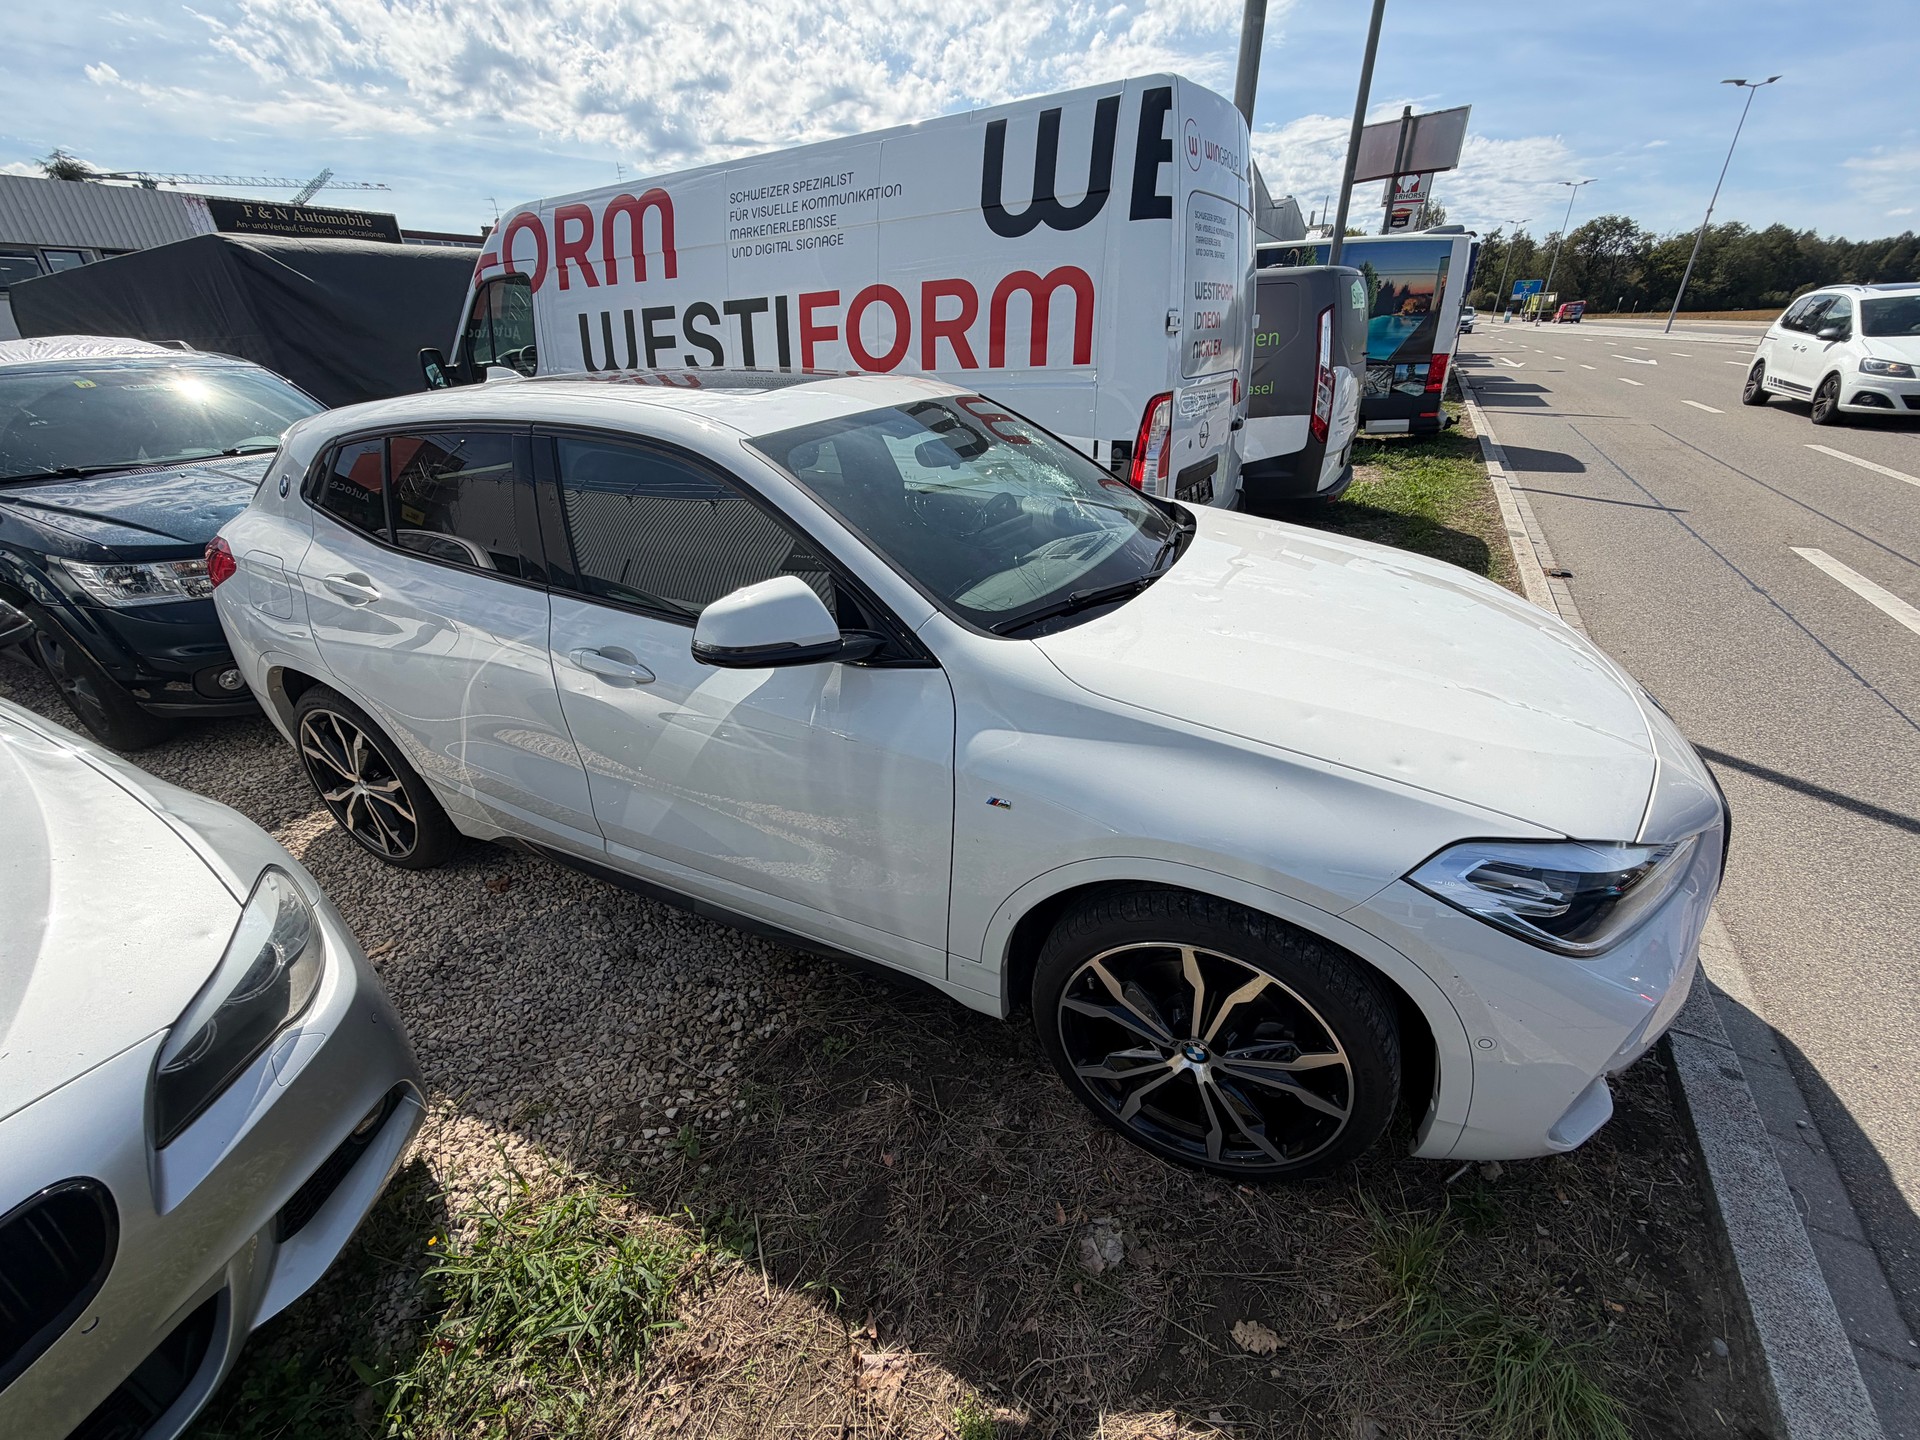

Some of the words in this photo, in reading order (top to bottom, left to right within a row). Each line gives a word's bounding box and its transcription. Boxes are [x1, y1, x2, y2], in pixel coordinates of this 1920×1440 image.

[981, 86, 1172, 238] WE
[729, 183, 790, 204] SCHWEIZER
[792, 171, 854, 194] SPEZIALIST
[1383, 192, 1426, 201] IERHORSE
[729, 206, 749, 222] FÜR
[751, 201, 799, 219] VISUELLE
[801, 183, 902, 211] KOMMUNIKATION
[242, 204, 253, 218] F
[258, 206, 272, 219] &
[274, 207, 289, 221] N
[293, 210, 373, 228] Automobile
[729, 214, 837, 240] MARKENERLEBNISSE
[236, 220, 251, 229] An-
[252, 222, 268, 230] und
[267, 223, 299, 233] Verkauf,
[299, 225, 334, 235] Eintausch
[348, 229, 387, 239] Occasionen
[732, 246, 753, 259] UND
[755, 241, 794, 256] DIGITAL
[796, 233, 844, 251] SIGNAGE
[578, 265, 1095, 373] WESTIFORM
